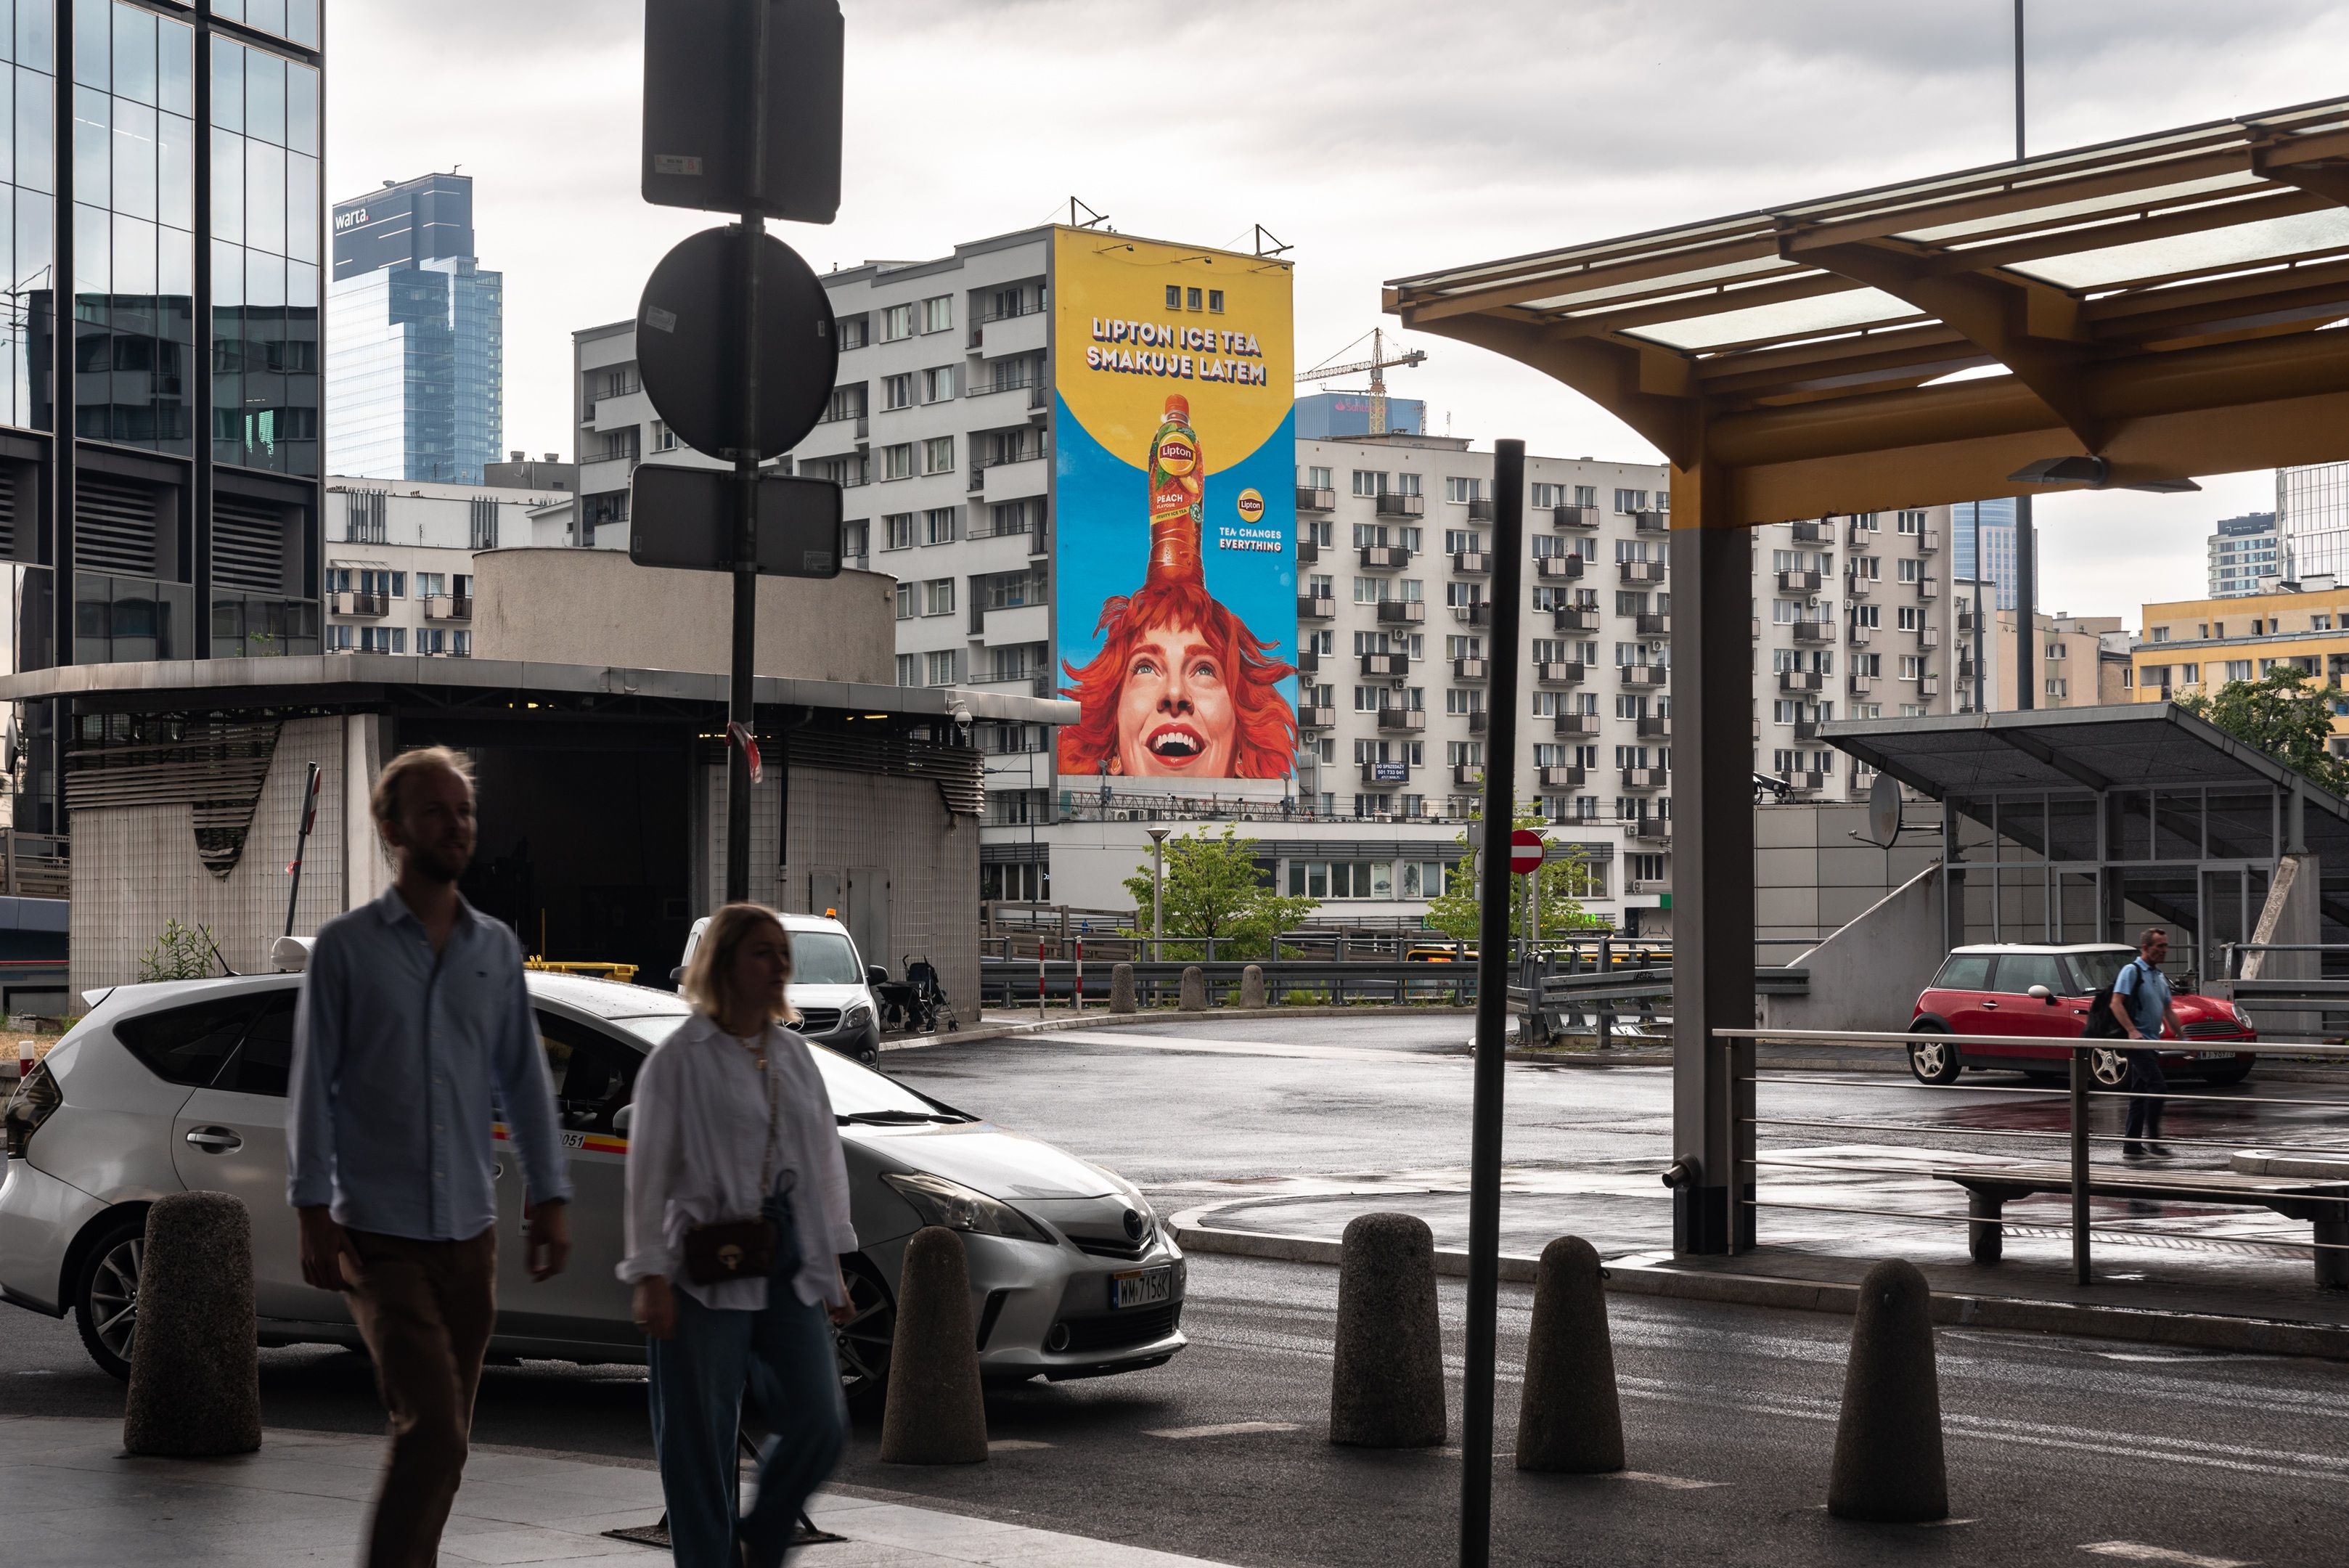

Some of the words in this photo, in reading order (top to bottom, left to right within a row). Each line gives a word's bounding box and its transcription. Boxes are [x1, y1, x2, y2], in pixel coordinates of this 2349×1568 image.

[1092, 317, 1174, 348] LIPTON
[1180, 327, 1217, 353] ICE
[1221, 330, 1262, 357] TEA
[1087, 346, 1193, 380] SMAKUJE
[1199, 356, 1266, 386] LATEM
[1162, 446, 1191, 458] Lipton
[1156, 494, 1183, 504] PEACH
[1241, 500, 1260, 510] Lipton
[1220, 527, 1237, 536] TEA
[1239, 528, 1282, 539] CHANGES
[1220, 538, 1283, 554] EVERYTHING
[1121, 1279, 1135, 1304] WM
[1139, 1273, 1168, 1301] 7156K
